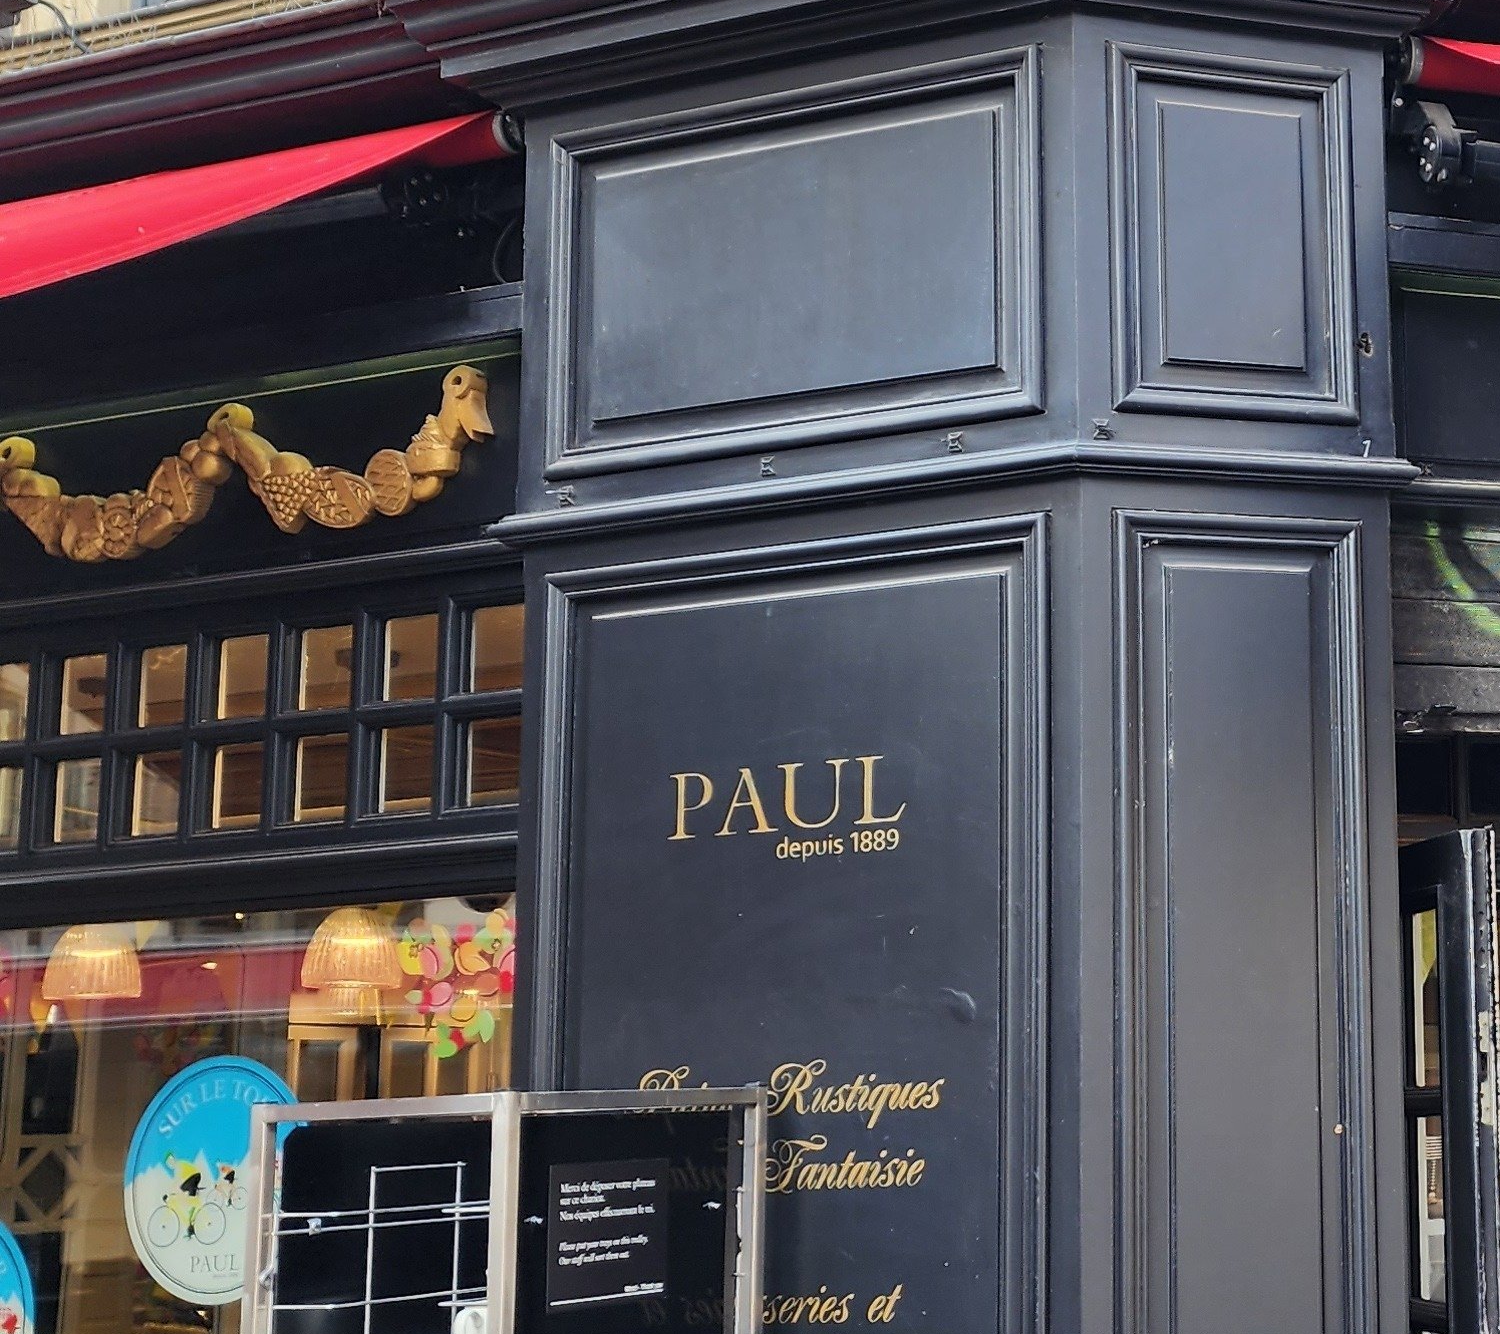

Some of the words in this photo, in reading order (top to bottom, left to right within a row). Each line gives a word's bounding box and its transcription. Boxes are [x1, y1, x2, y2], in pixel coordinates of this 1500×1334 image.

[667, 755, 907, 841] PAUL
[776, 833, 844, 863] depuis
[850, 827, 900, 853] 1889
[158, 1091, 198, 1139] SUR
[199, 1079, 227, 1105] LE
[766, 1059, 946, 1129] Rustiques
[765, 1134, 926, 1194] Fantaisie
[190, 1253, 239, 1273] PAUL
[762, 1284, 856, 1324] series
[867, 1283, 903, 1324] et
